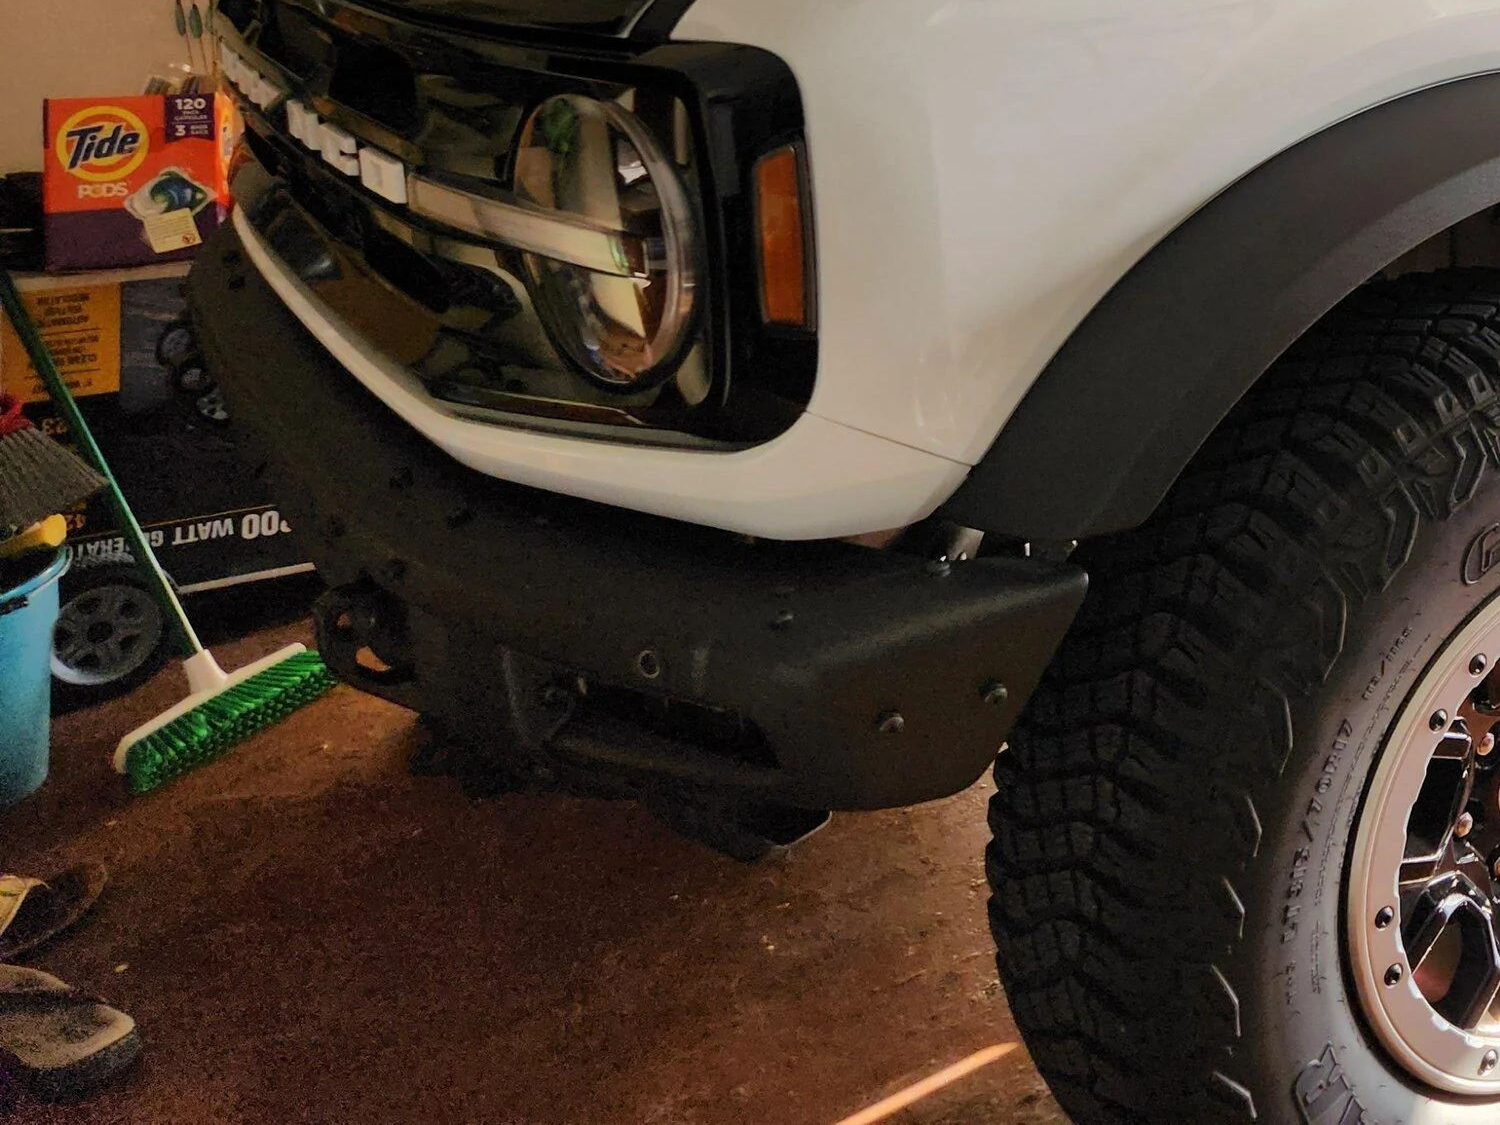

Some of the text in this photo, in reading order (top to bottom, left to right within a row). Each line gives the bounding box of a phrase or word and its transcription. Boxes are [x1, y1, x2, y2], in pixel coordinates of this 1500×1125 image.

[175, 97, 207, 111] 120
[175, 126, 185, 136] 3
[66, 124, 141, 170] Tide
[77, 182, 129, 199] PODS
[172, 517, 234, 545] WATT
[66, 530, 164, 564] GERAT
